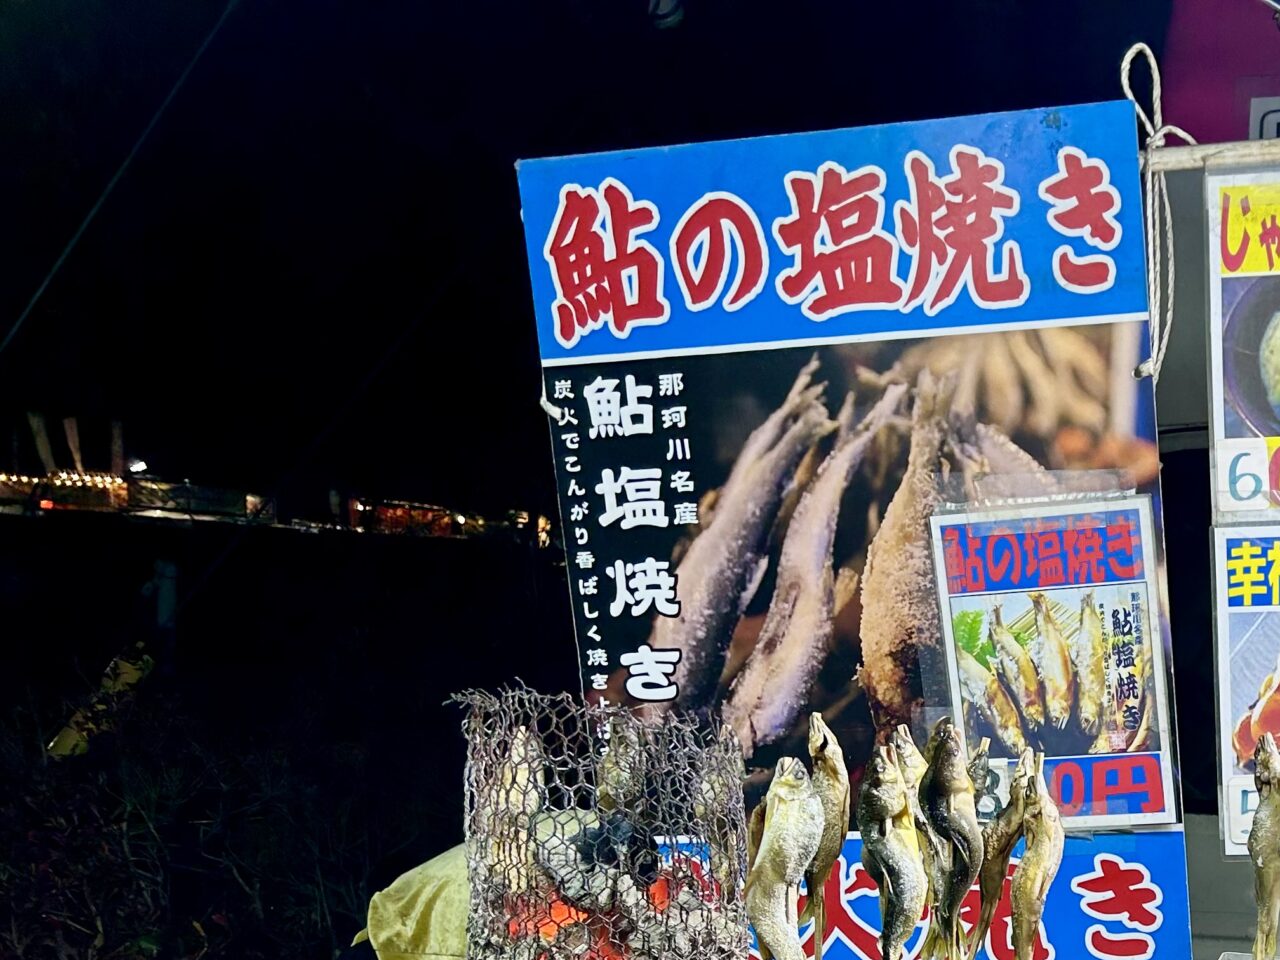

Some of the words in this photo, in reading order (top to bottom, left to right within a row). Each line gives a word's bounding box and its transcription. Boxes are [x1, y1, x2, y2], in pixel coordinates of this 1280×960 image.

[545, 143, 1123, 350] 鮎の塩焼き
[583, 374, 682, 701] 鮎塩焼き
[659, 372, 699, 525] 那珂川名産
[943, 513, 1143, 594] 鮎の塩焼き
